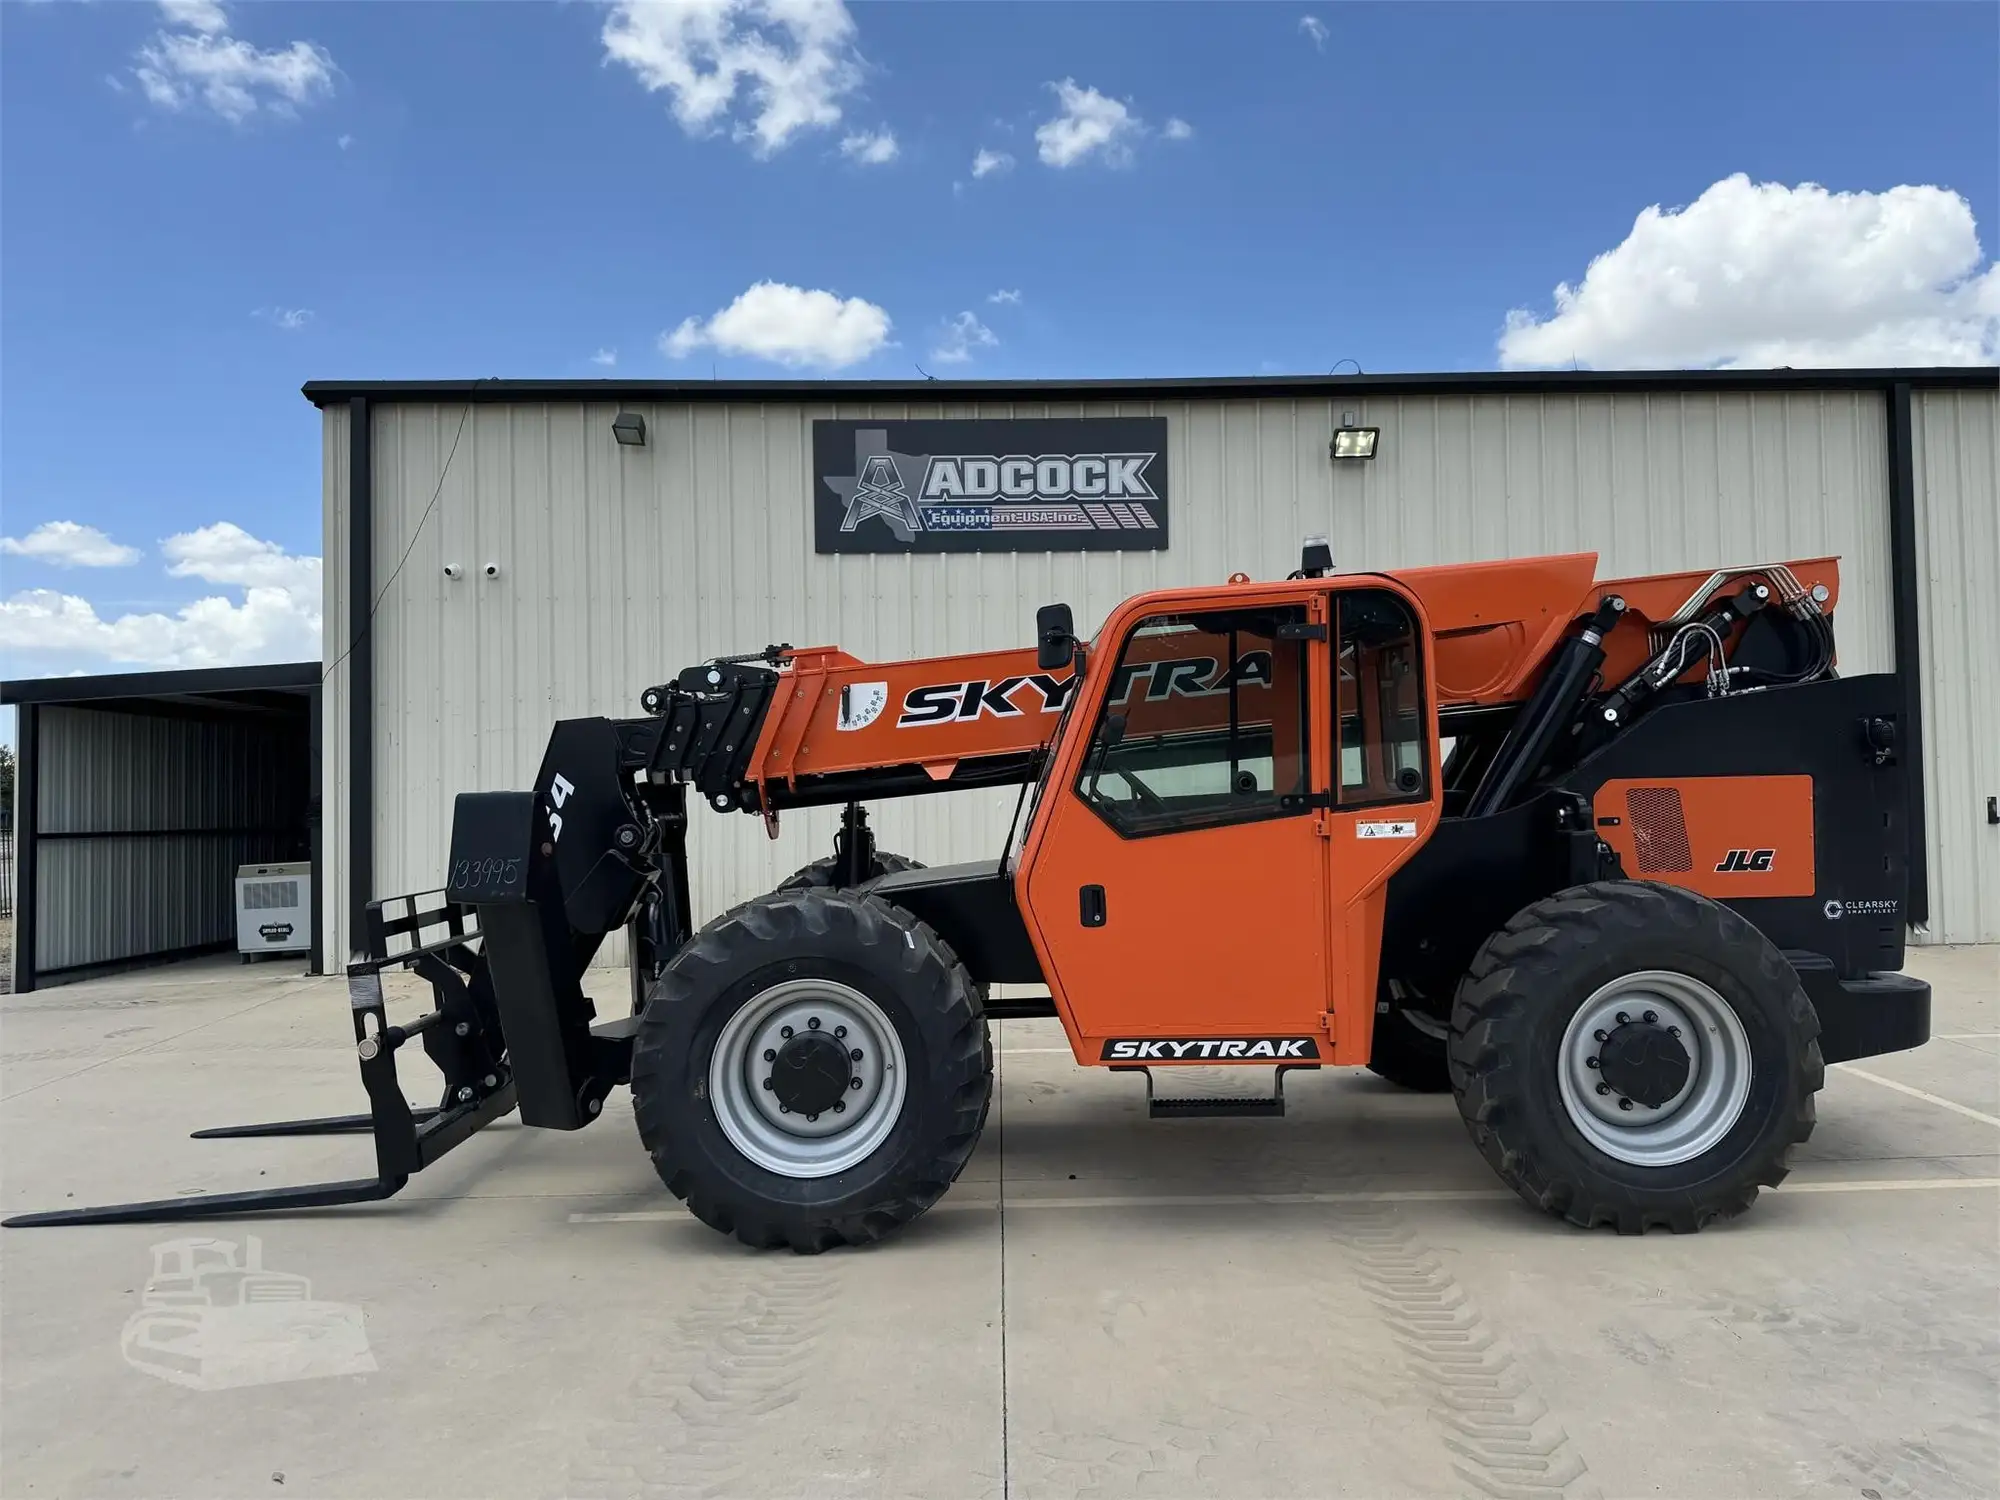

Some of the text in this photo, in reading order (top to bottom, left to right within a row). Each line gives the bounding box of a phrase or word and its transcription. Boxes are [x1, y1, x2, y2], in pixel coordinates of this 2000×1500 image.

[921, 455, 1150, 499] ADCOCK
[931, 512, 1016, 525] Equipment
[1022, 511, 1051, 523] USA
[896, 645, 1354, 728] SKYTRA
[1714, 849, 1776, 872] JLG
[449, 857, 522, 889] 133995
[1845, 900, 1898, 909] CLEARSKY
[1110, 1039, 1308, 1059] SKYTRAK
